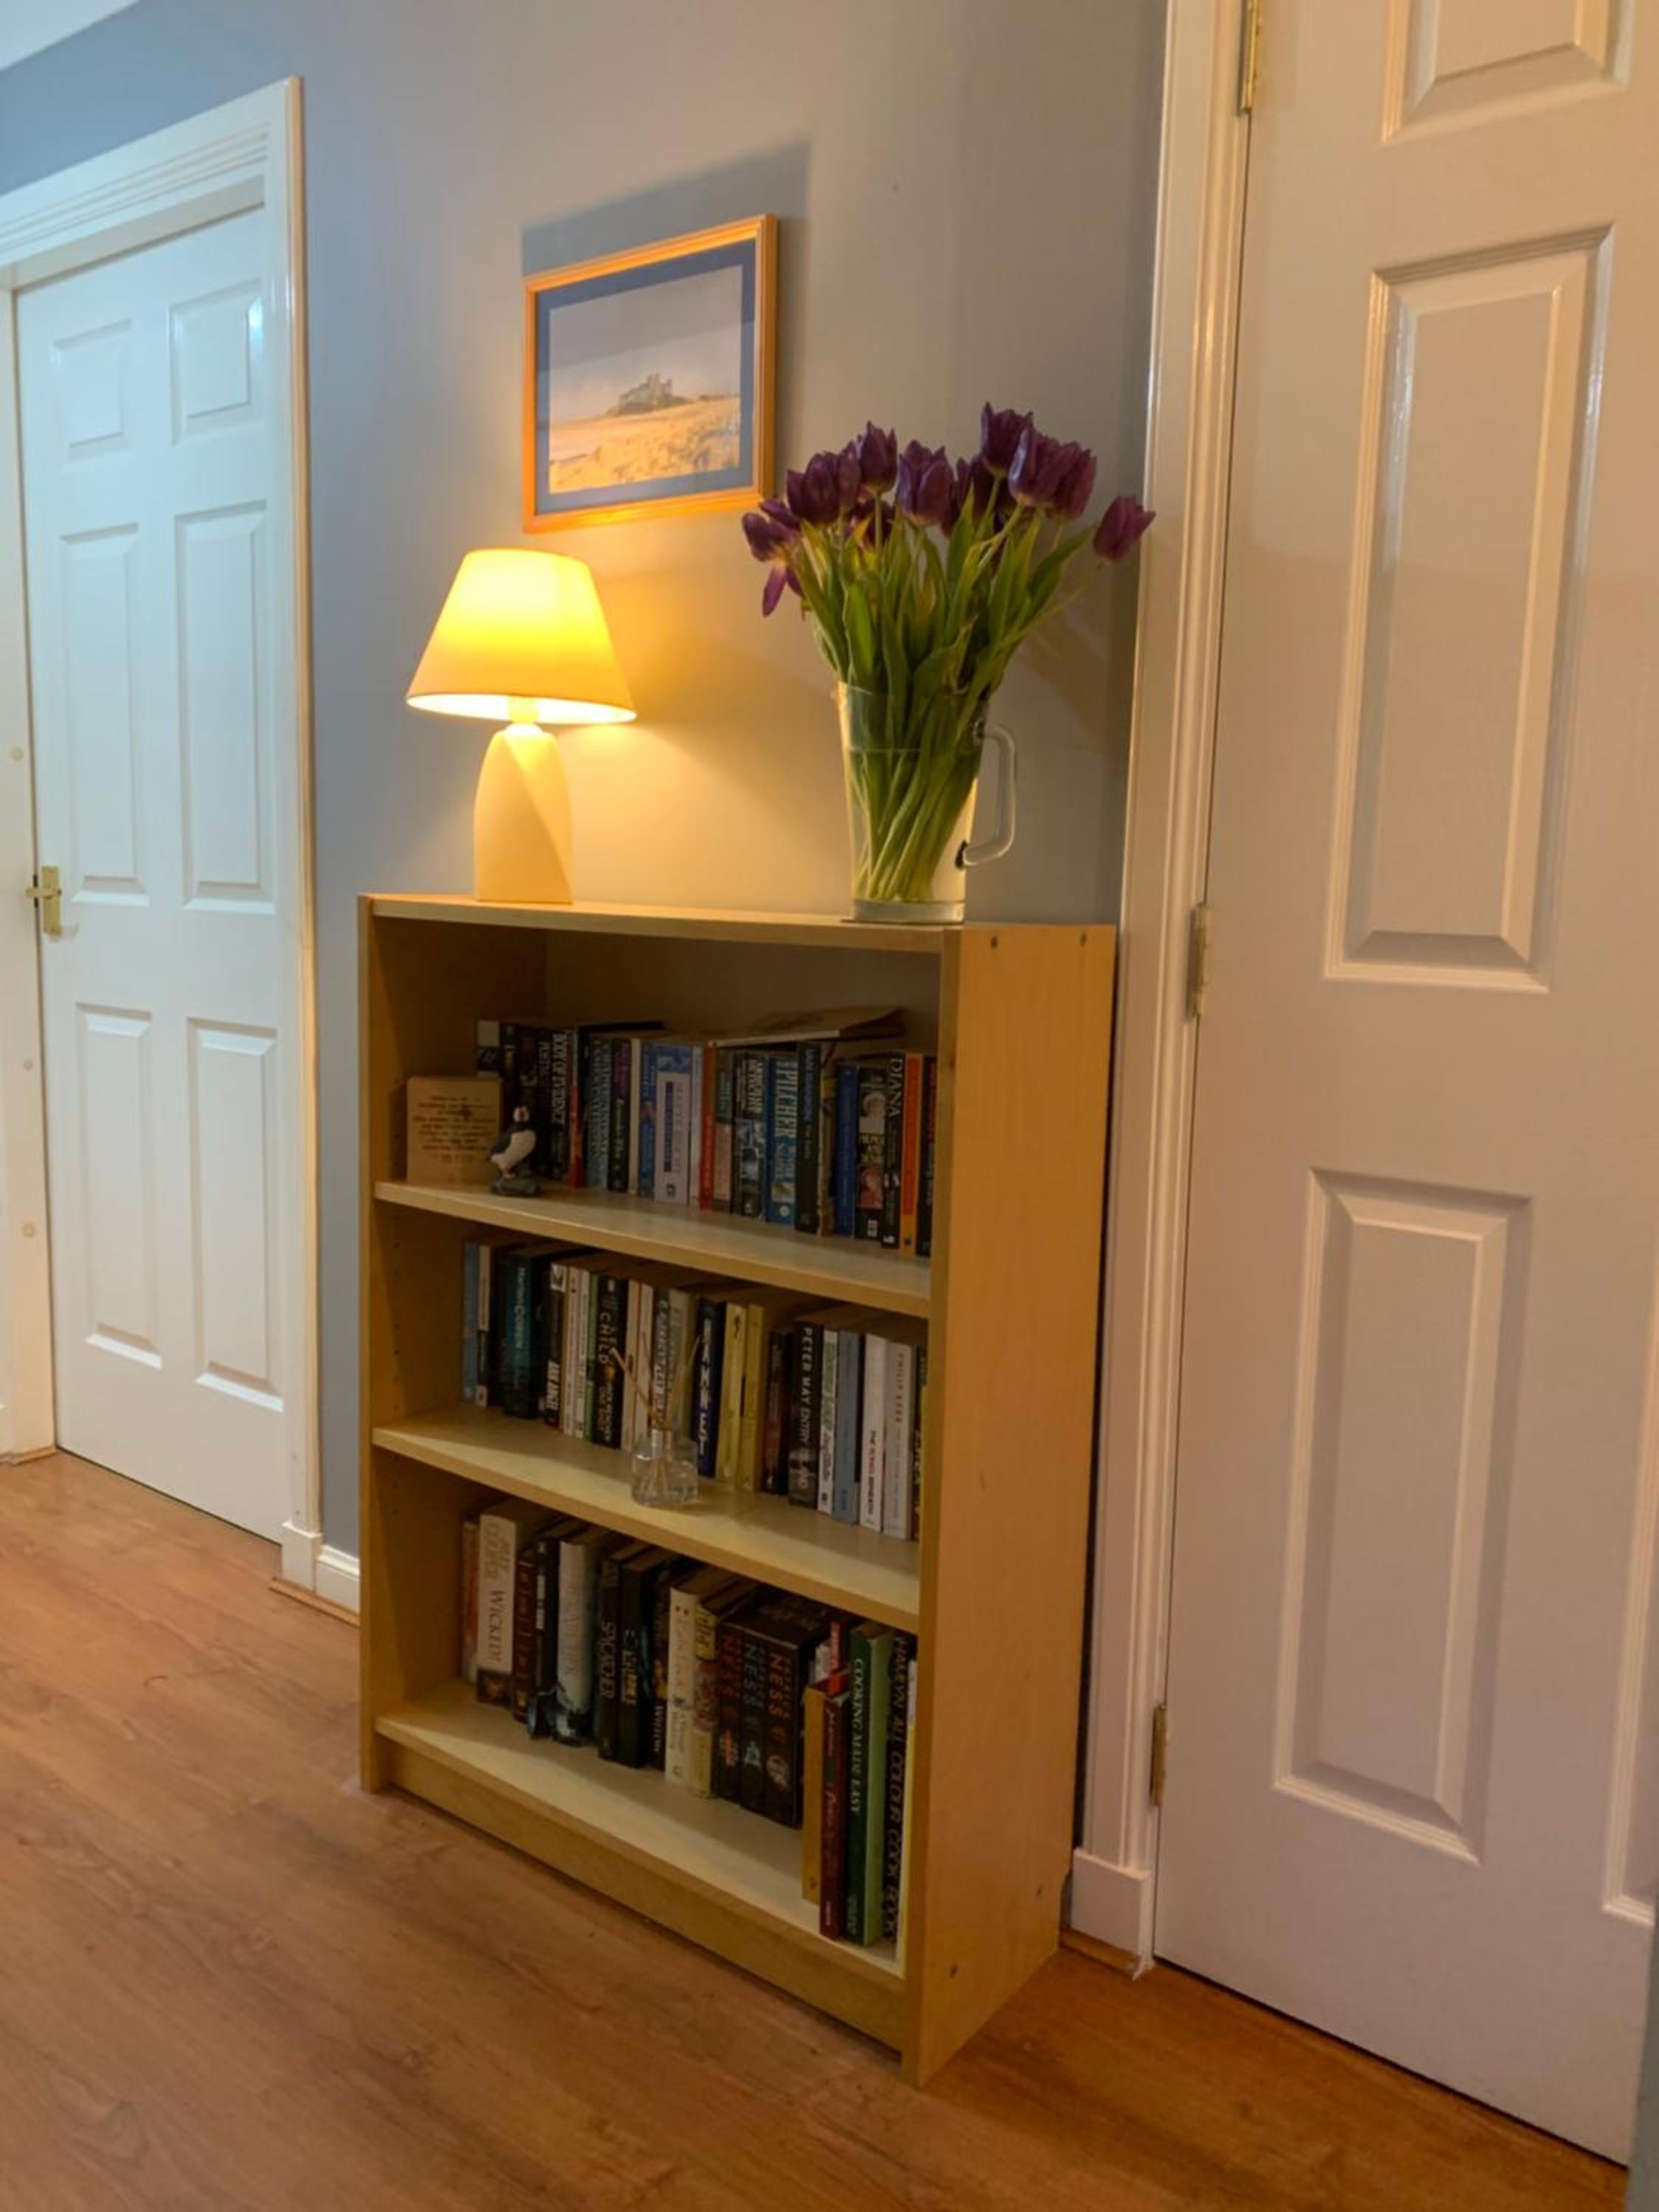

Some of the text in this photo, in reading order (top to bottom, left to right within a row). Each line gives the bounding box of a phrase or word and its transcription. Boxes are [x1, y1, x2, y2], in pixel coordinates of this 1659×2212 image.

[888, 1057, 904, 1116] DIANA
[598, 1311, 611, 1365] CHILD
[801, 1326, 813, 1371] PETER
[801, 1376, 812, 1405] MAY
[601, 1618, 616, 1699] SPYCATCHER
[767, 1652, 783, 1716] NESS
[849, 1658, 863, 1815] COOKING MADE EASY
